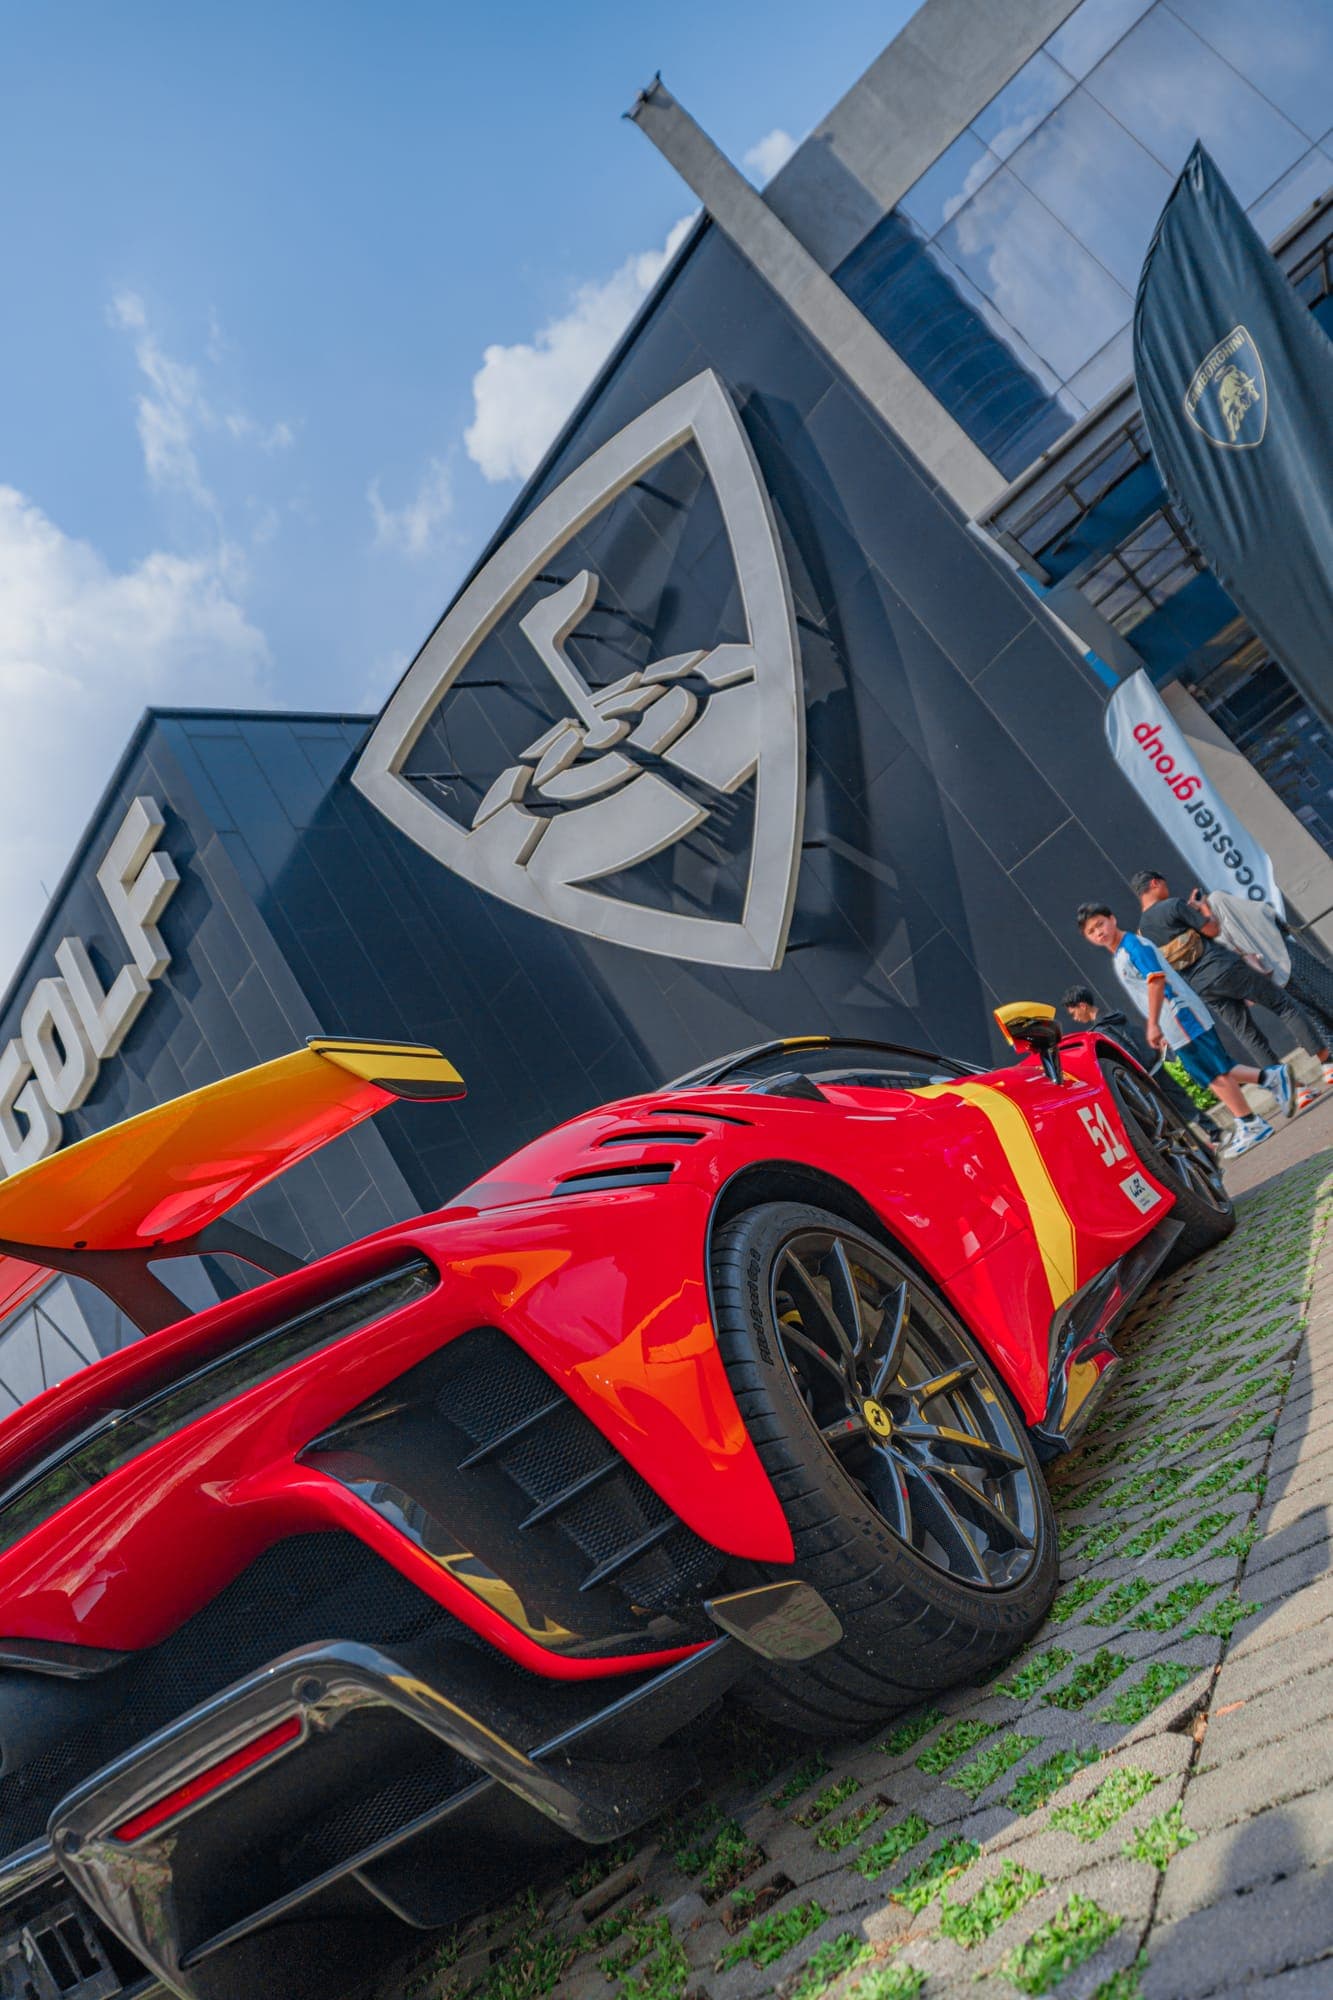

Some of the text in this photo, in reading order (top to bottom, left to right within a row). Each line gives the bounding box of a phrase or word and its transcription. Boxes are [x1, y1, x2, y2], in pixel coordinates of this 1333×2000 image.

[1186, 332, 1246, 413] LAMBORGHINI
[0, 796, 180, 1177] GOLF
[1076, 1102, 1128, 1168] 51
